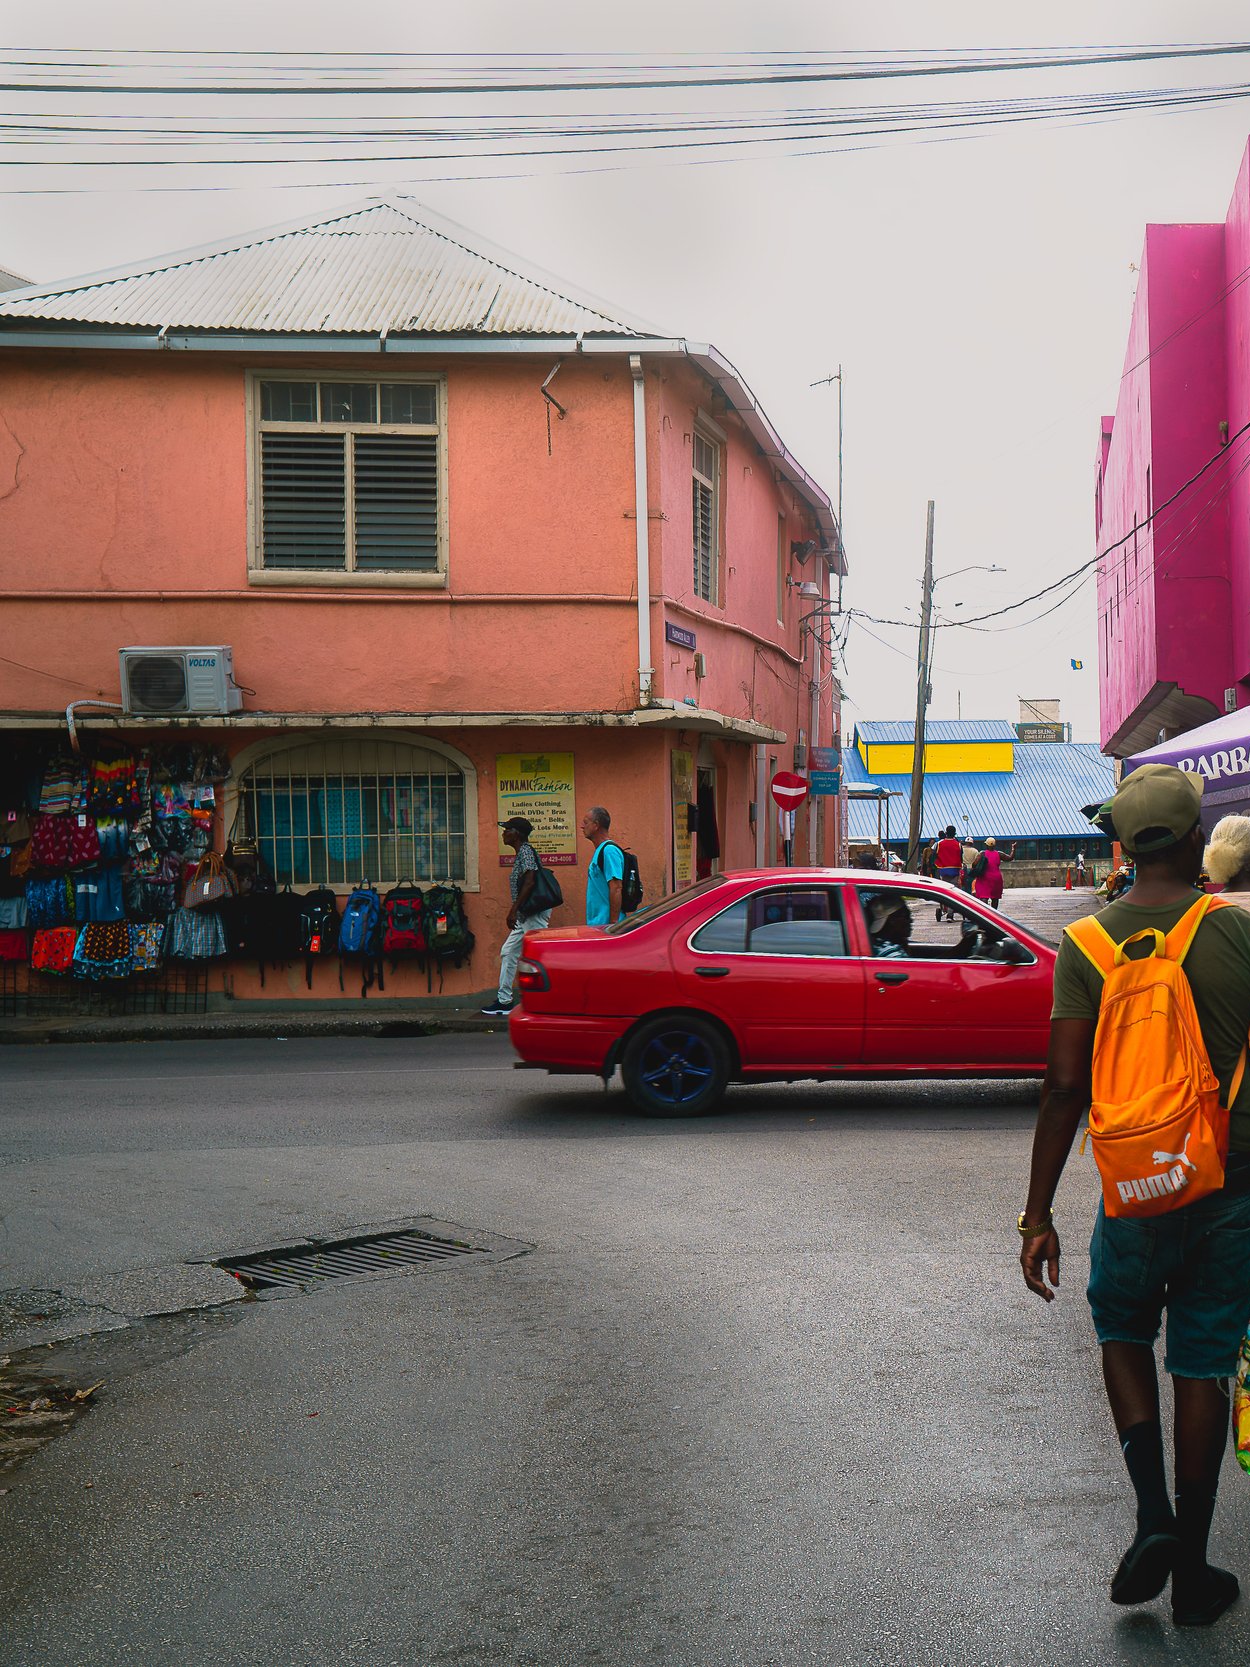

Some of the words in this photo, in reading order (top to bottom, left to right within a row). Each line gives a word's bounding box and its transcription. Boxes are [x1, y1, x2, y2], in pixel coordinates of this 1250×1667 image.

[189, 659, 216, 667] VOLTAS
[500, 780, 533, 792] DYNAMIC
[532, 777, 573, 793] Fashion
[1116, 1164, 1189, 1204] PUMA
